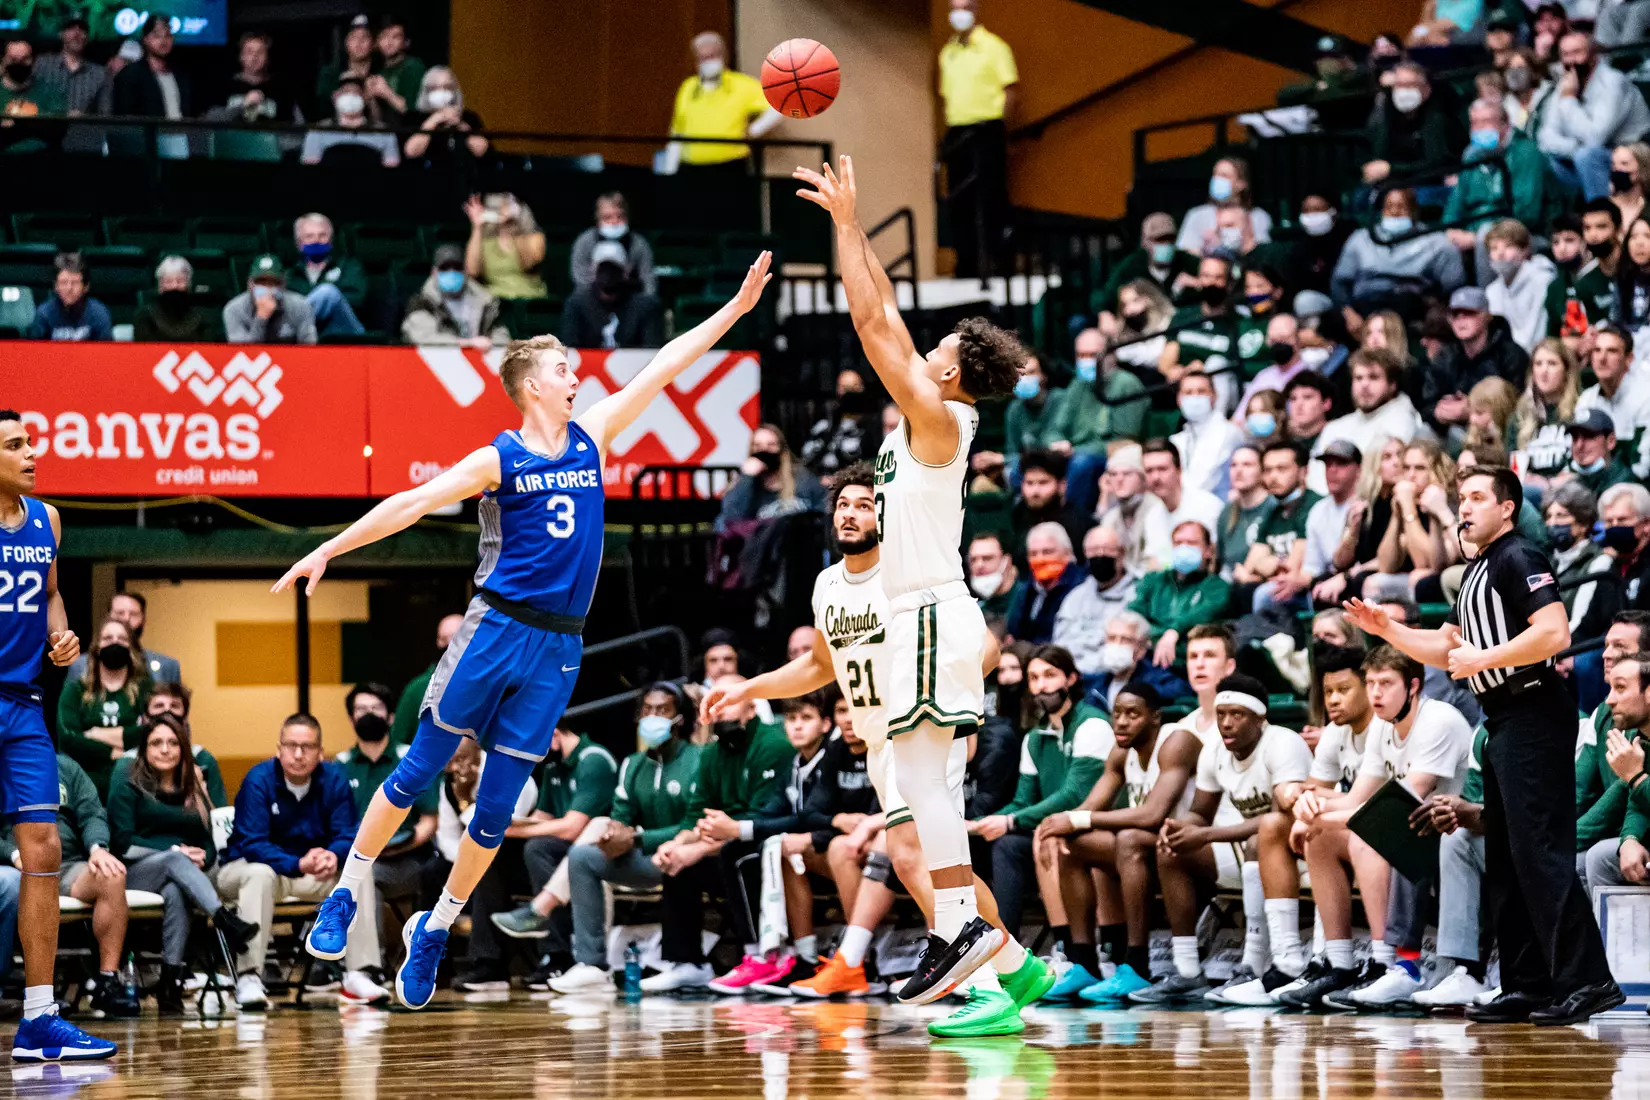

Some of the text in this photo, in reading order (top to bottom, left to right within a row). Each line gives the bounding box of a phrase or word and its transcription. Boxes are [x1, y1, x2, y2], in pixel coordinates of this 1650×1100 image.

[22, 411, 260, 460] canvas
[156, 466, 258, 484] credit union
[515, 470, 598, 493] AIR FORCE
[546, 494, 575, 538] 3
[2, 545, 52, 564] FORCE
[0, 570, 42, 613] 22
[825, 603, 883, 637] Colorado
[847, 659, 882, 707] 21
